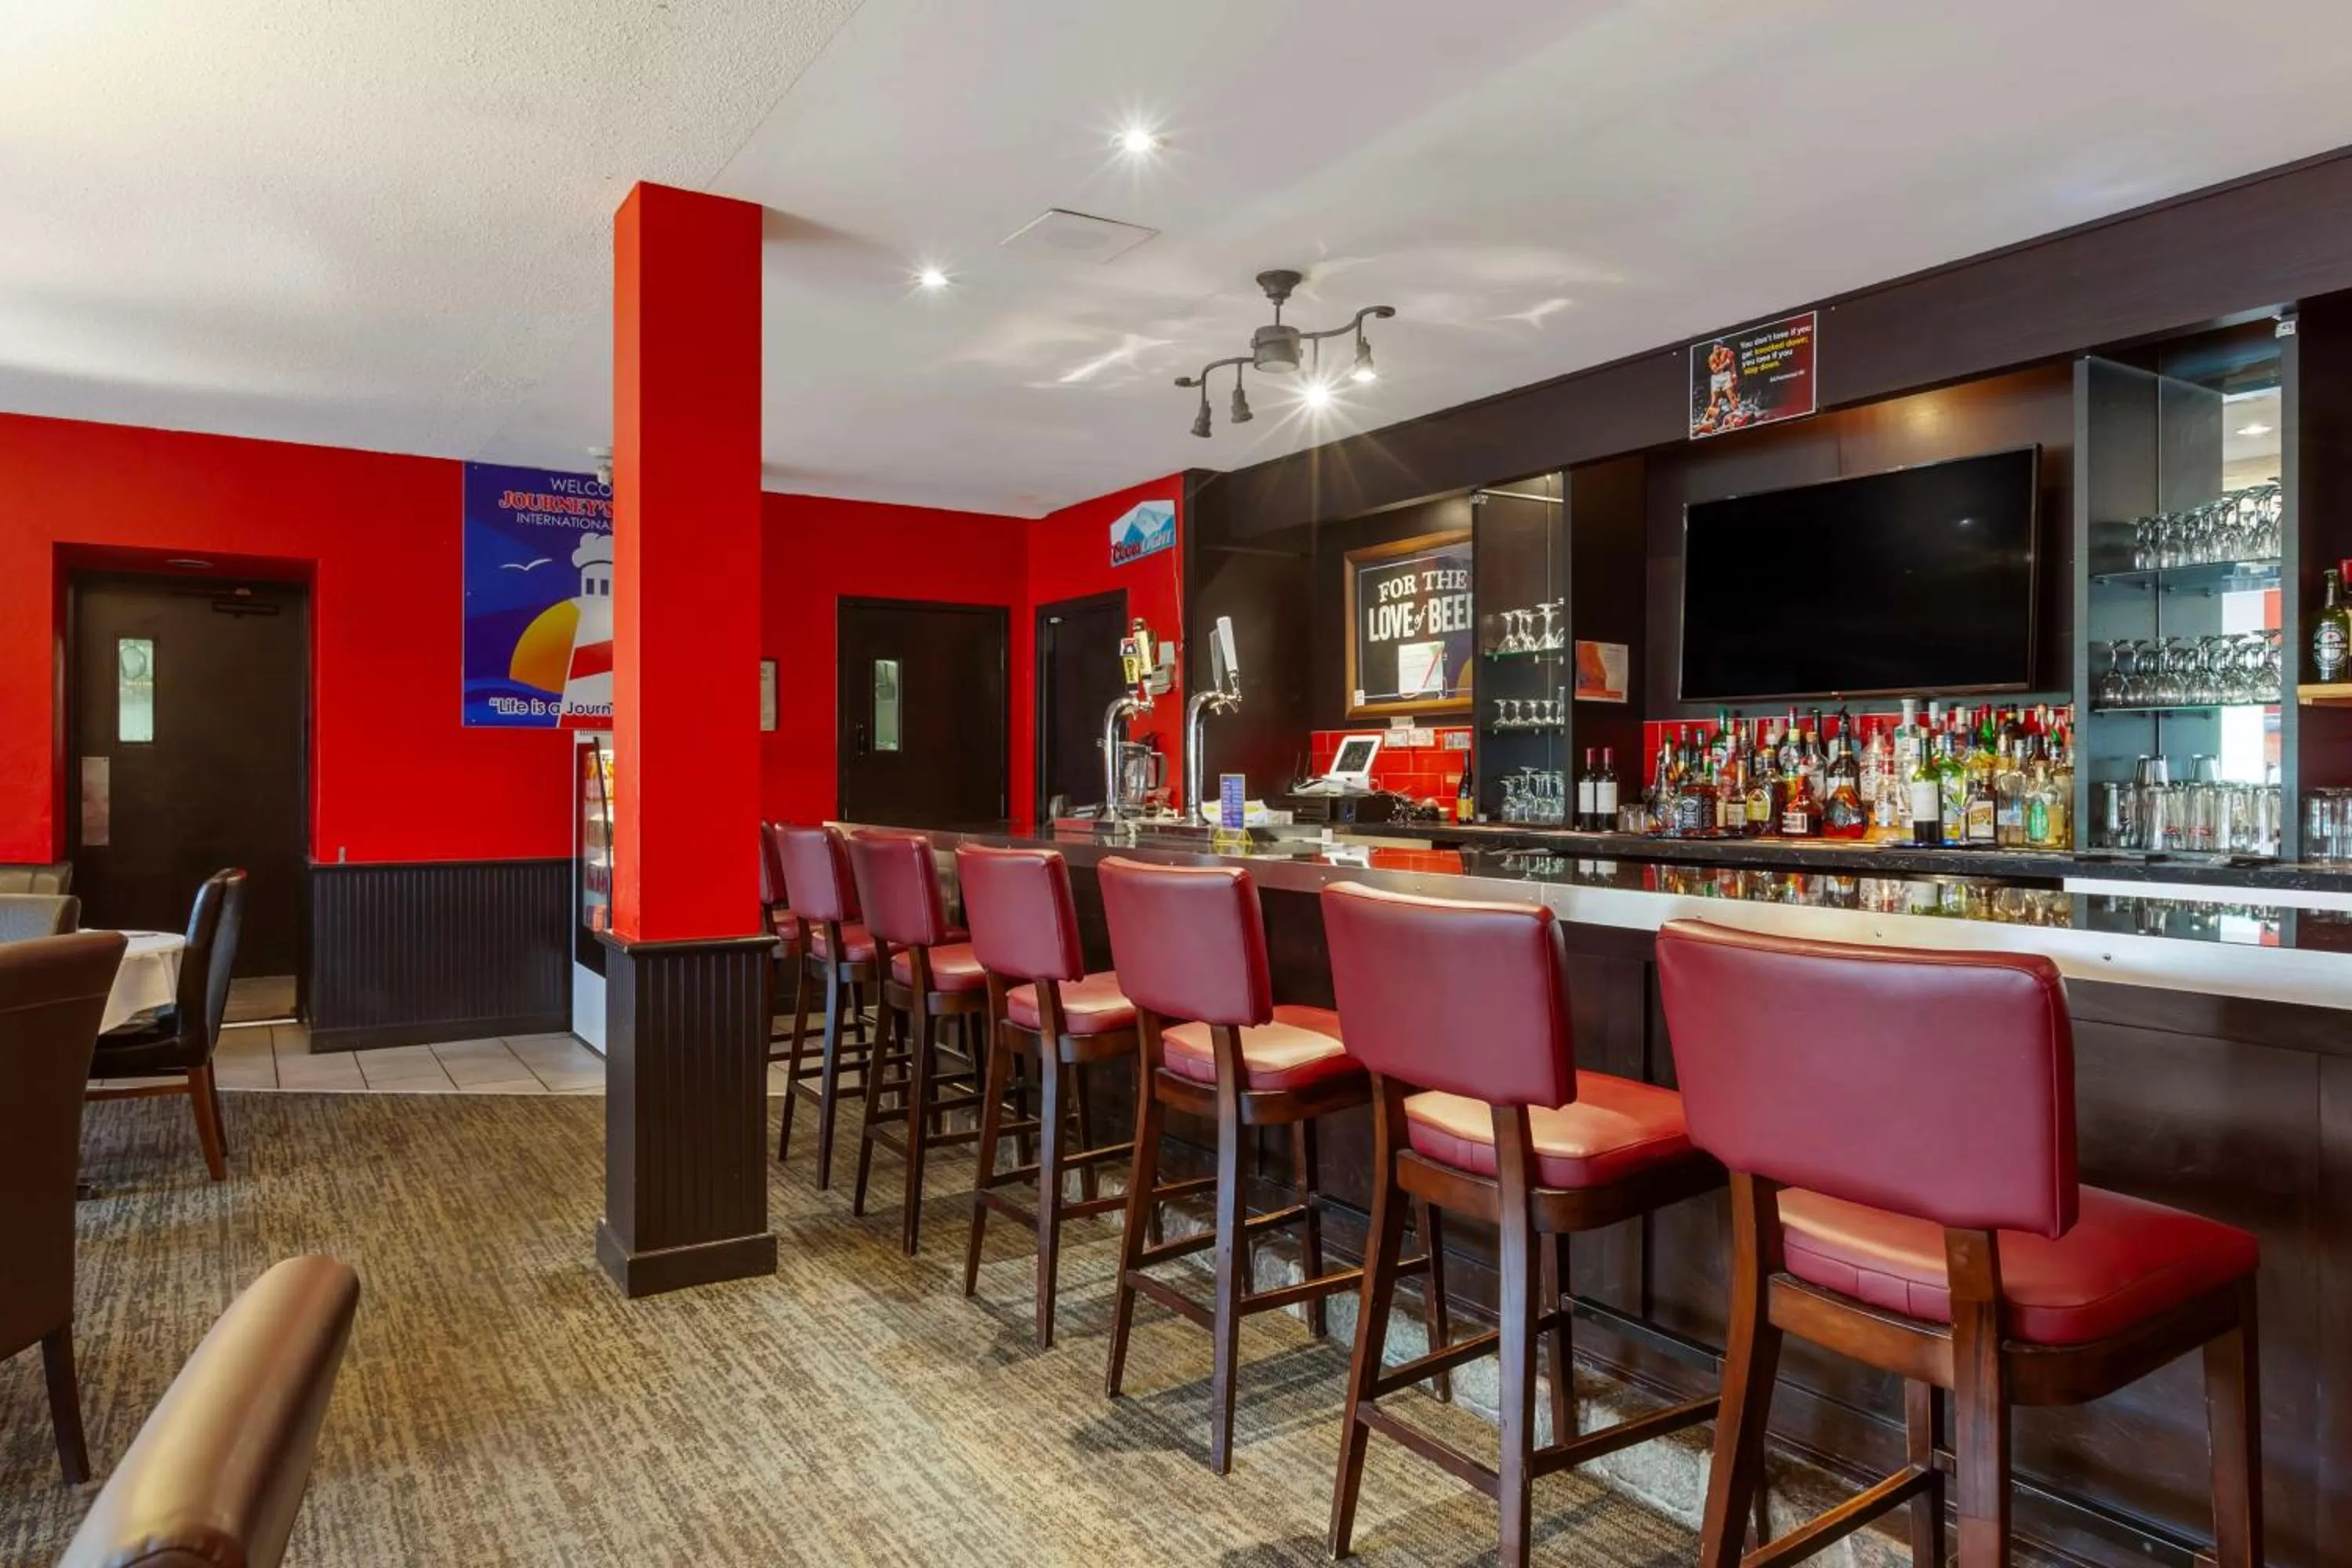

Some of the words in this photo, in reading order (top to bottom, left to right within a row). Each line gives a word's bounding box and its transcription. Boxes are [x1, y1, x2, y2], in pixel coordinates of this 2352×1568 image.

[1796, 325, 1812, 336] you
[1777, 348, 1793, 359] you
[517, 512, 613, 531] INTERNATIONA
[1378, 575, 1417, 603] FOR
[1421, 570, 1468, 590] THE
[1368, 602, 1414, 642] LOVE
[531, 698, 546, 715] is
[549, 702, 561, 715] a
[566, 701, 612, 717] Journ
